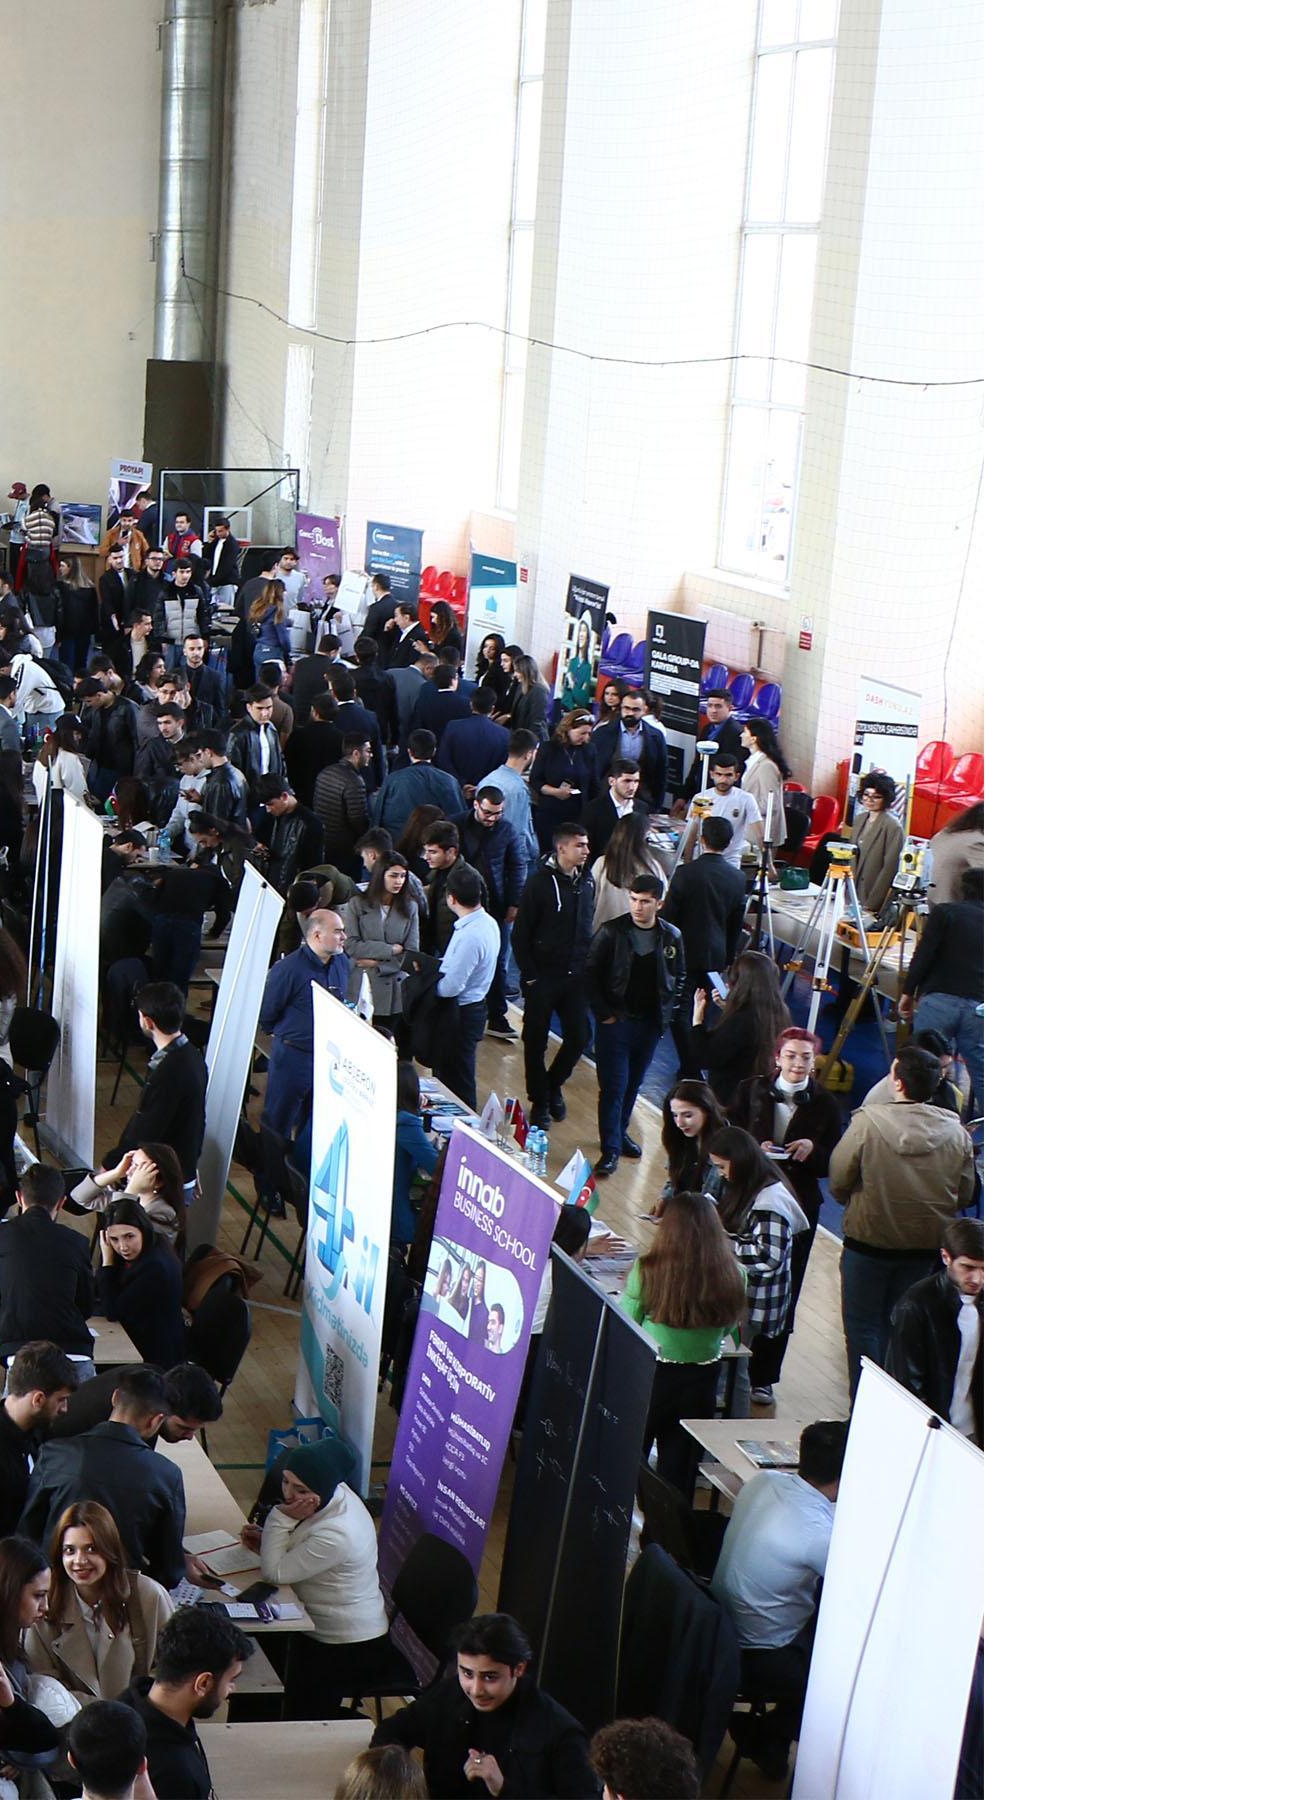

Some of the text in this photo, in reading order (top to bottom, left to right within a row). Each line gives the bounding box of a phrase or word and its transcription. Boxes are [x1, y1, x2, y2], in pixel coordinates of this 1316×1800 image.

[456, 1155, 506, 1218] innab
[453, 1190, 537, 1272] BUSINESS SCHOOL
